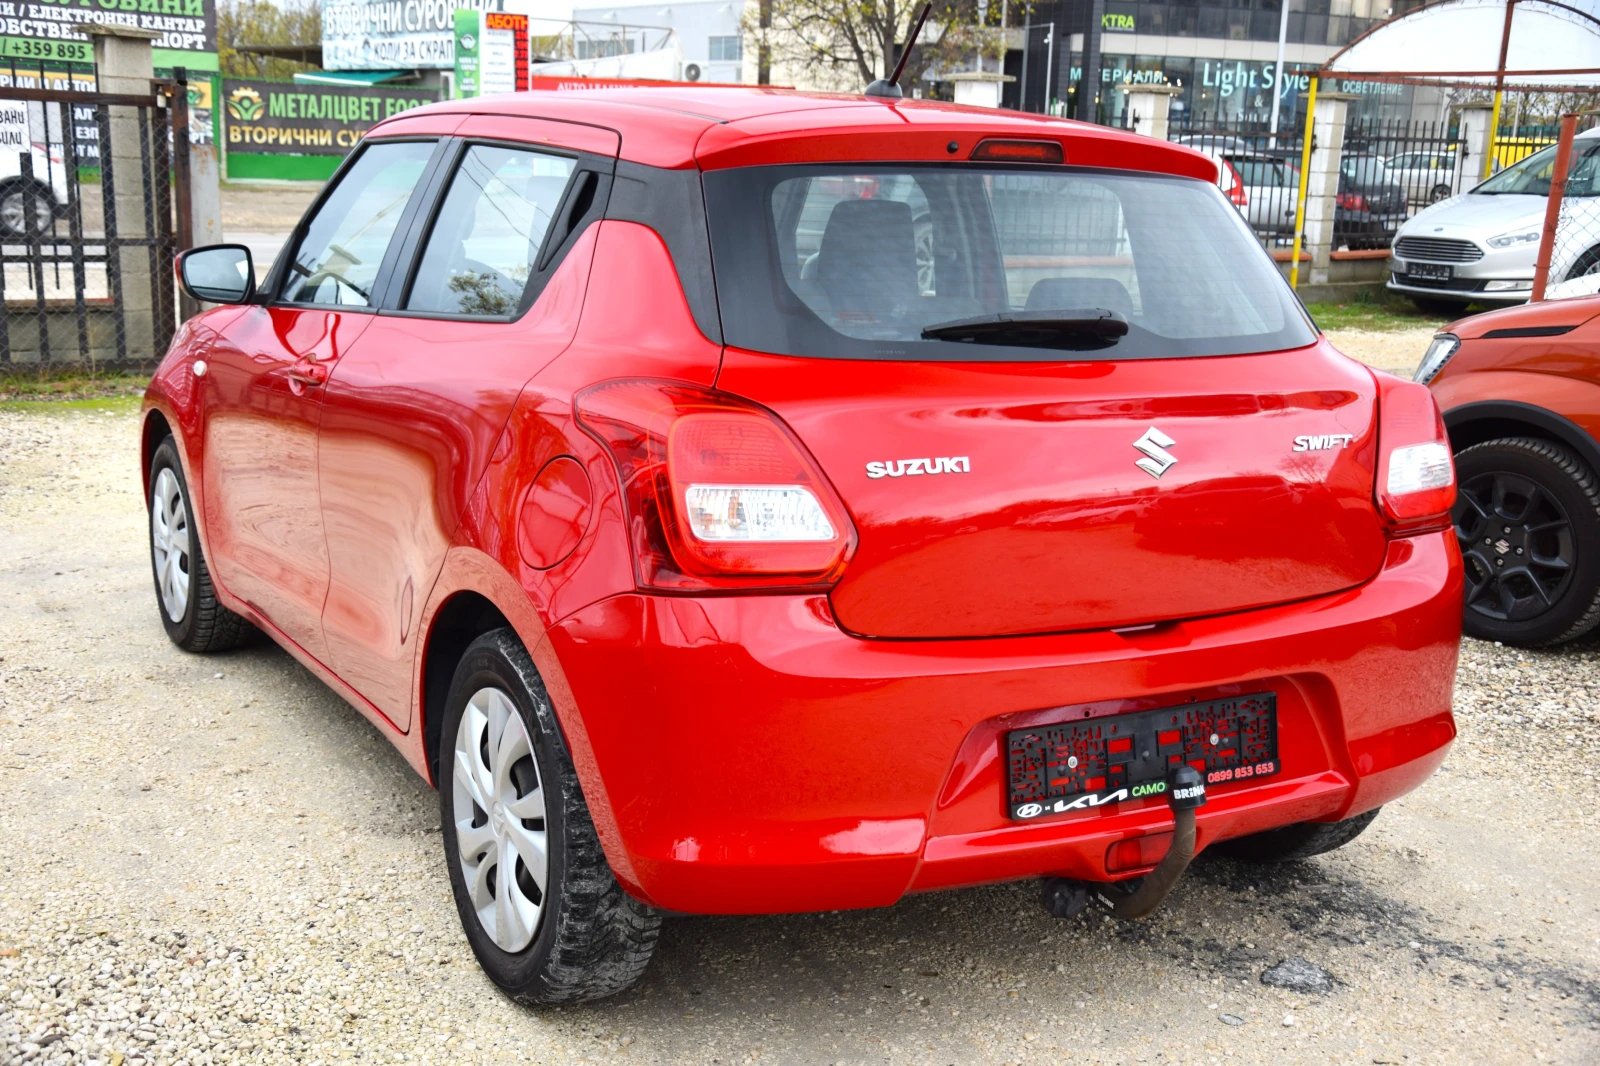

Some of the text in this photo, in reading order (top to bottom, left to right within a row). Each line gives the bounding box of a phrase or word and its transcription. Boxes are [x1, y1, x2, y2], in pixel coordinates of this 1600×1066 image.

[28, 4, 139, 28] ЕЛЕКТРОНЕН
[140, 15, 206, 33] КАНТАР
[326, 2, 402, 35] ВТОРИЧНИ
[12, 40, 52, 57] +359
[57, 43, 86, 59] 895
[403, 41, 416, 60] ЗА
[419, 39, 454, 59] СКРАП
[1070, 67, 1164, 84] МЕРИАЛИ
[1202, 61, 1310, 99] Light Syle
[1342, 80, 1404, 95] ОСВЕТЛЕНИЕ
[269, 92, 382, 124] МЕТАЛЦВЕТ
[1254, 94, 1264, 108] &
[229, 125, 332, 147] ВТОРИЧНИ
[1292, 434, 1354, 452] SWIFT
[866, 456, 971, 479] SUZUKI
[1208, 769, 1234, 783] 0899
[1234, 765, 1254, 778] 853
[1256, 762, 1275, 775] 653
